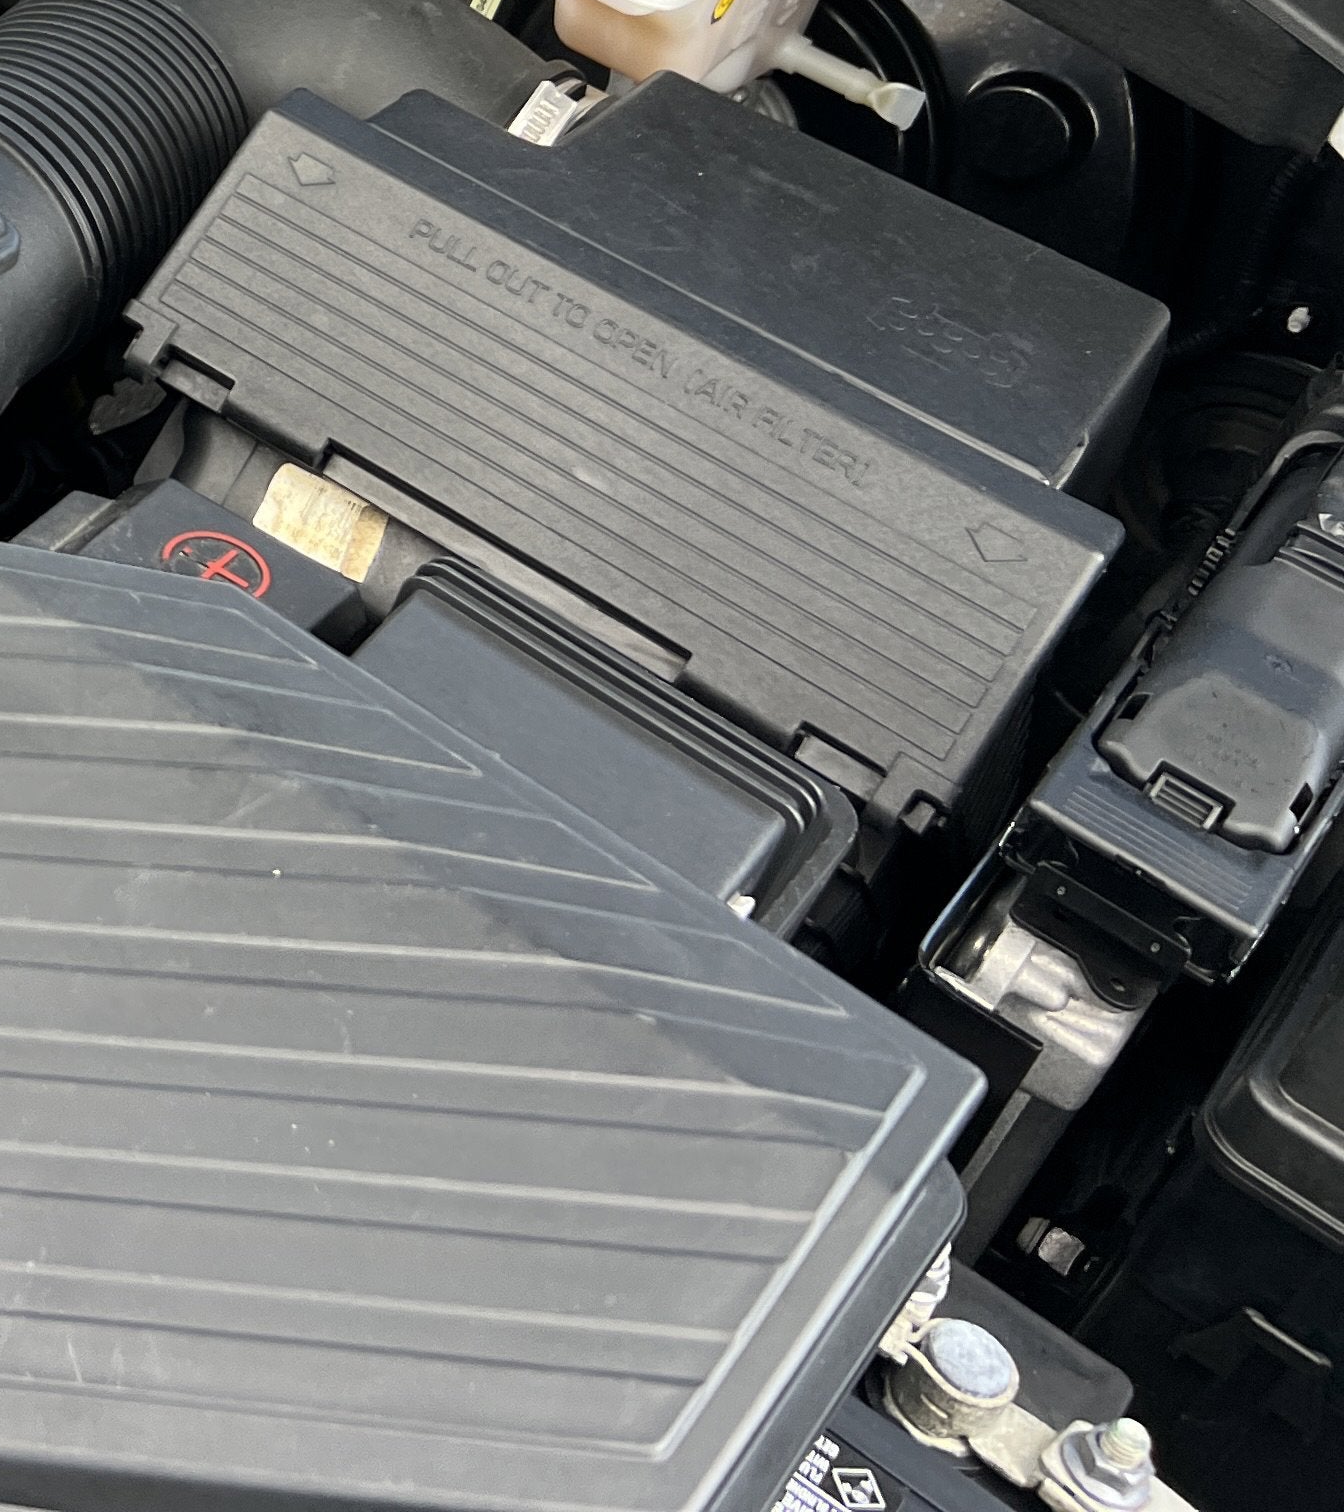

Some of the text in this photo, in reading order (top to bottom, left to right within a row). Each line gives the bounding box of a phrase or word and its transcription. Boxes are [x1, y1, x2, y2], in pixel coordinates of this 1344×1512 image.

[409, 217, 478, 273] PULL
[485, 258, 553, 305] OUT
[550, 291, 592, 330] TO
[592, 317, 681, 380] OPEN
